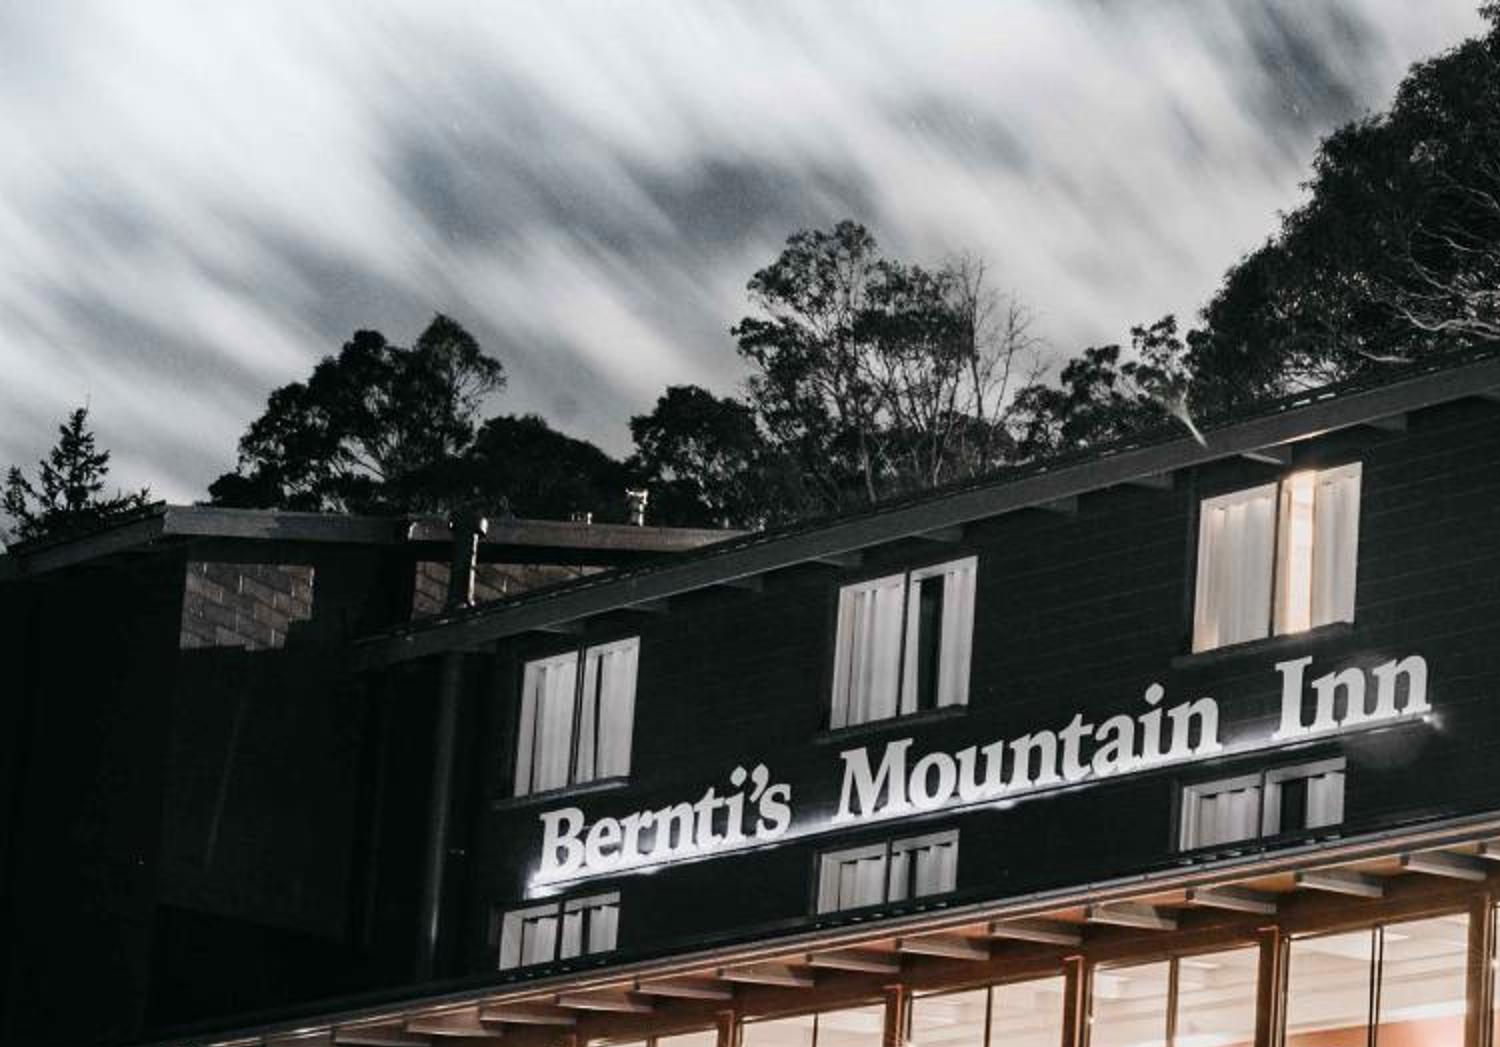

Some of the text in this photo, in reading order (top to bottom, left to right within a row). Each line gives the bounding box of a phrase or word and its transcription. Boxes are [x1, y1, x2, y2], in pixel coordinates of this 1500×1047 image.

[538, 654, 1431, 878] Bernti's Mountain Inn
